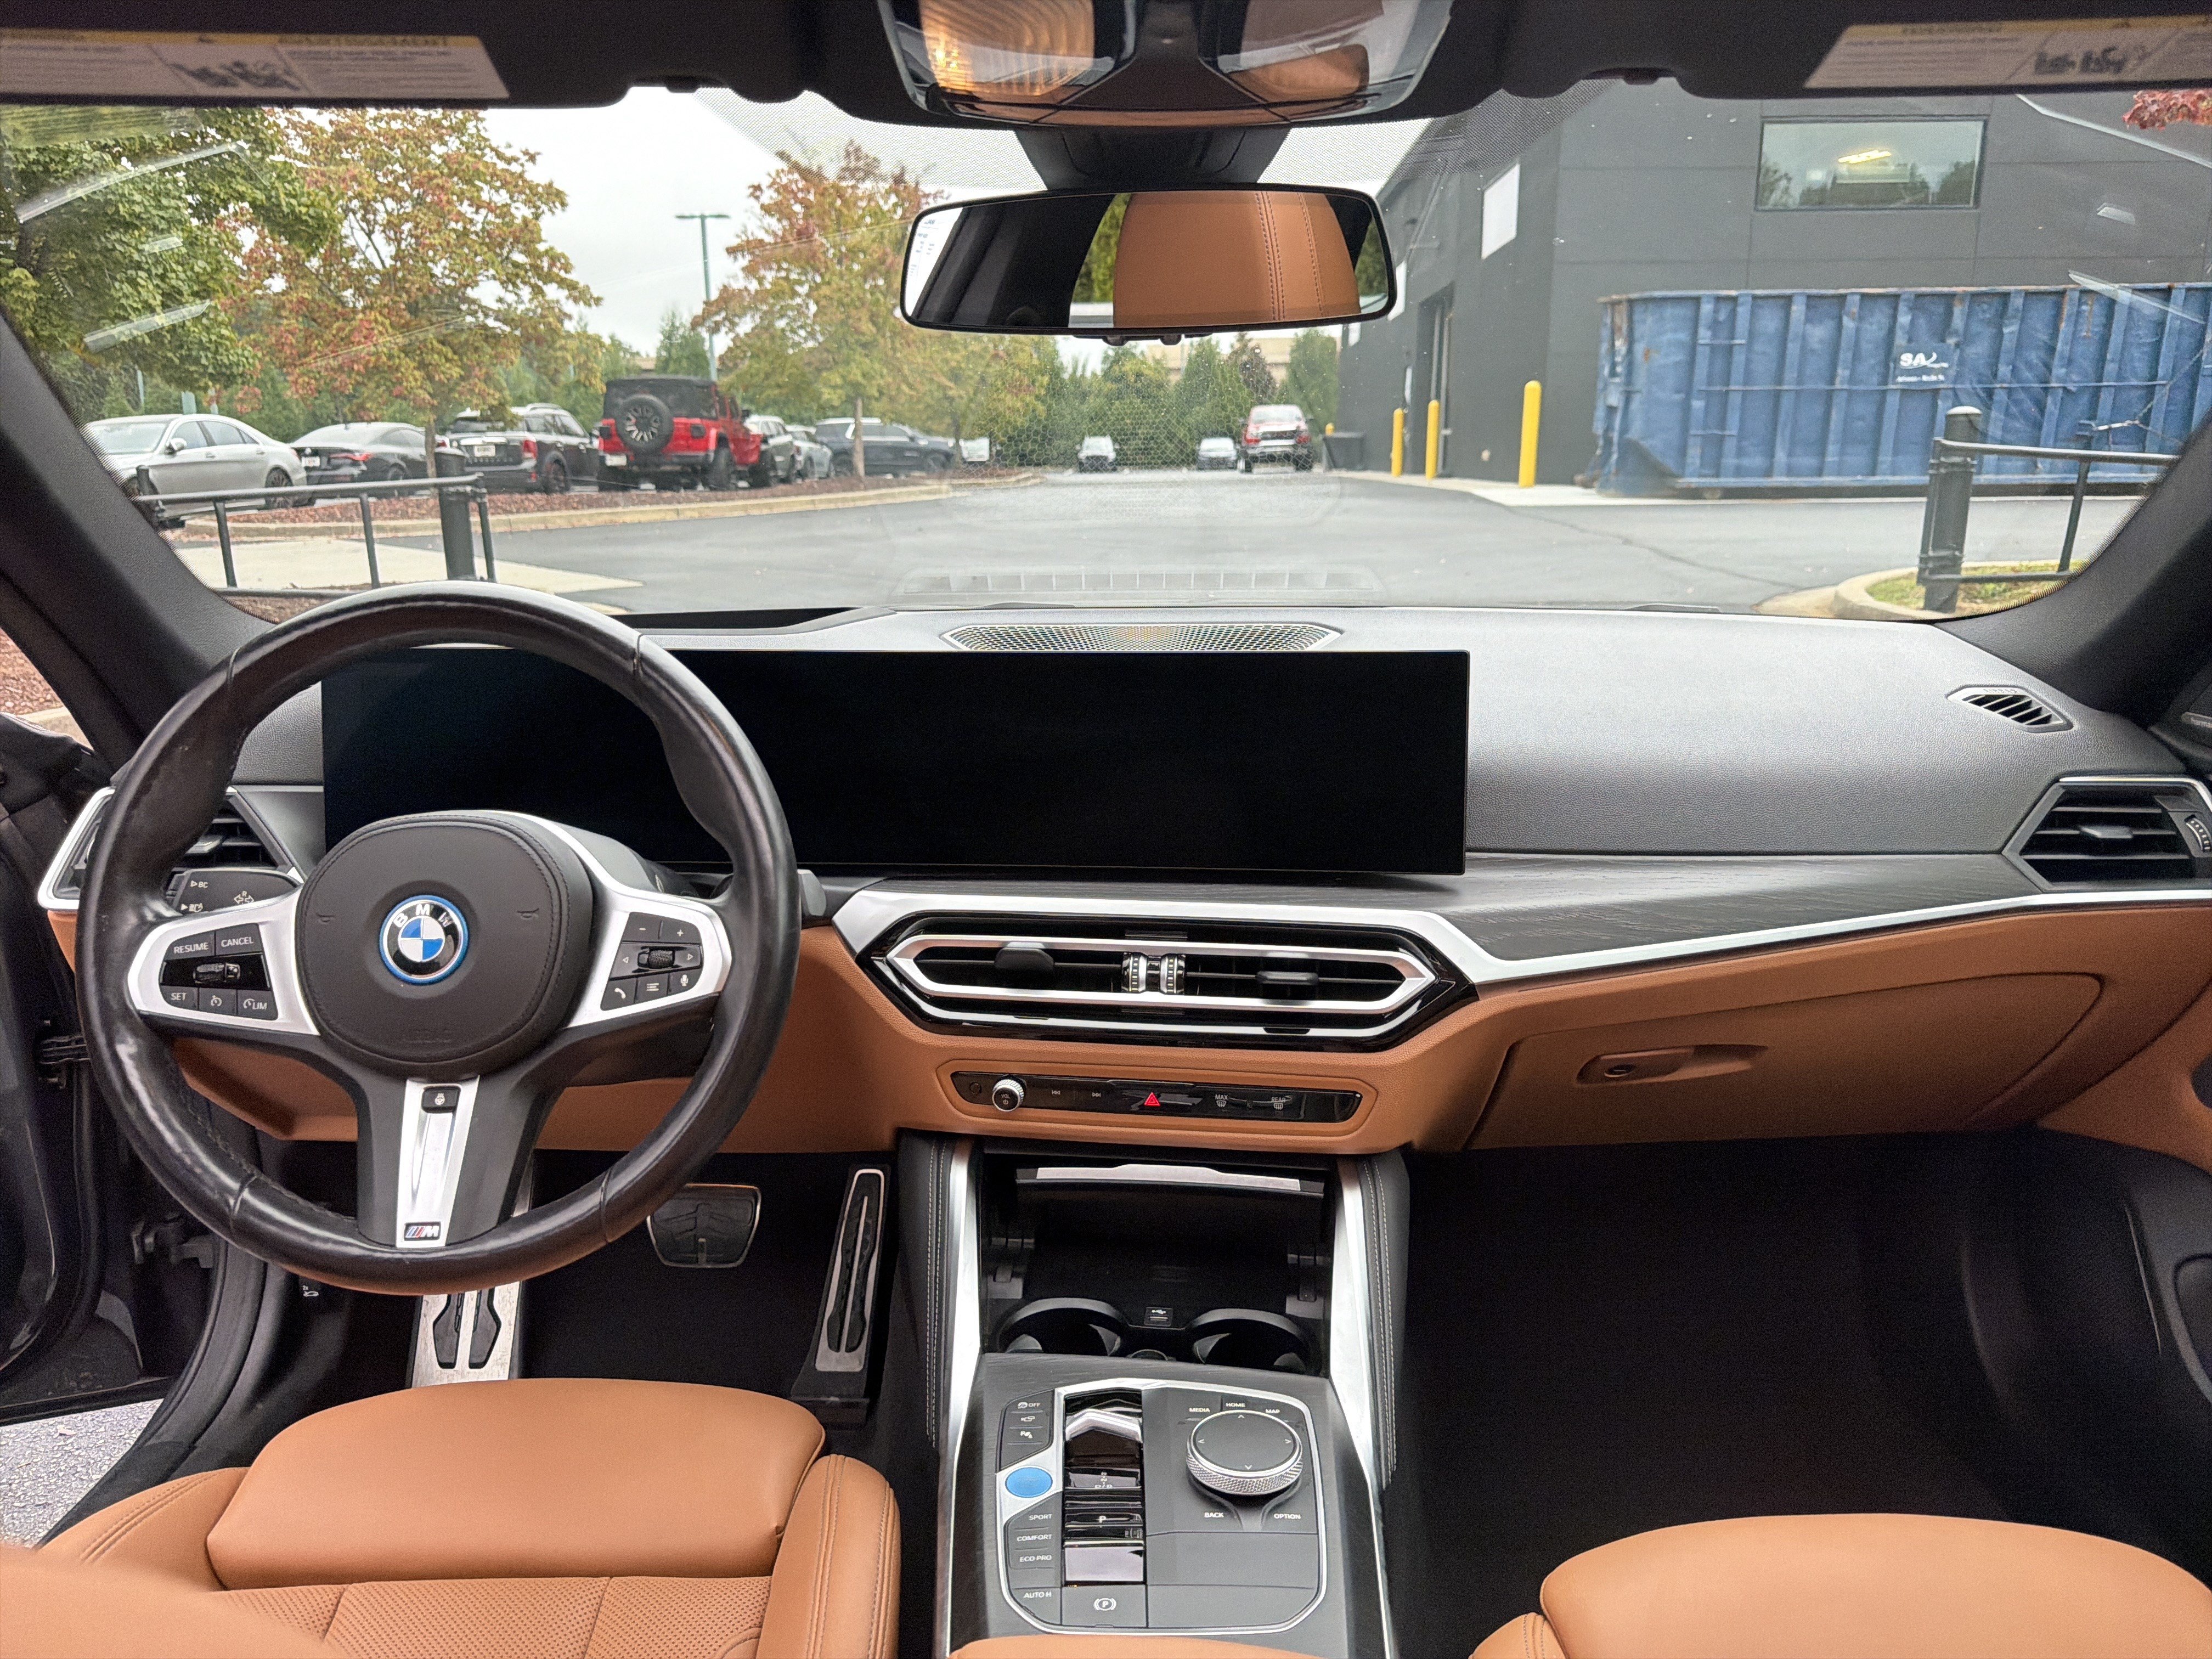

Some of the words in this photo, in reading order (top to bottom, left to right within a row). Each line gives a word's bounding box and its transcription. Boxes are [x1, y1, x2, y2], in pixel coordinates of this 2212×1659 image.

[393, 904, 455, 928] BMW
[221, 936, 254, 947] CANCEL
[173, 942, 209, 954] RESUME
[171, 992, 187, 1001] SET
[252, 1002, 268, 1011] LIM
